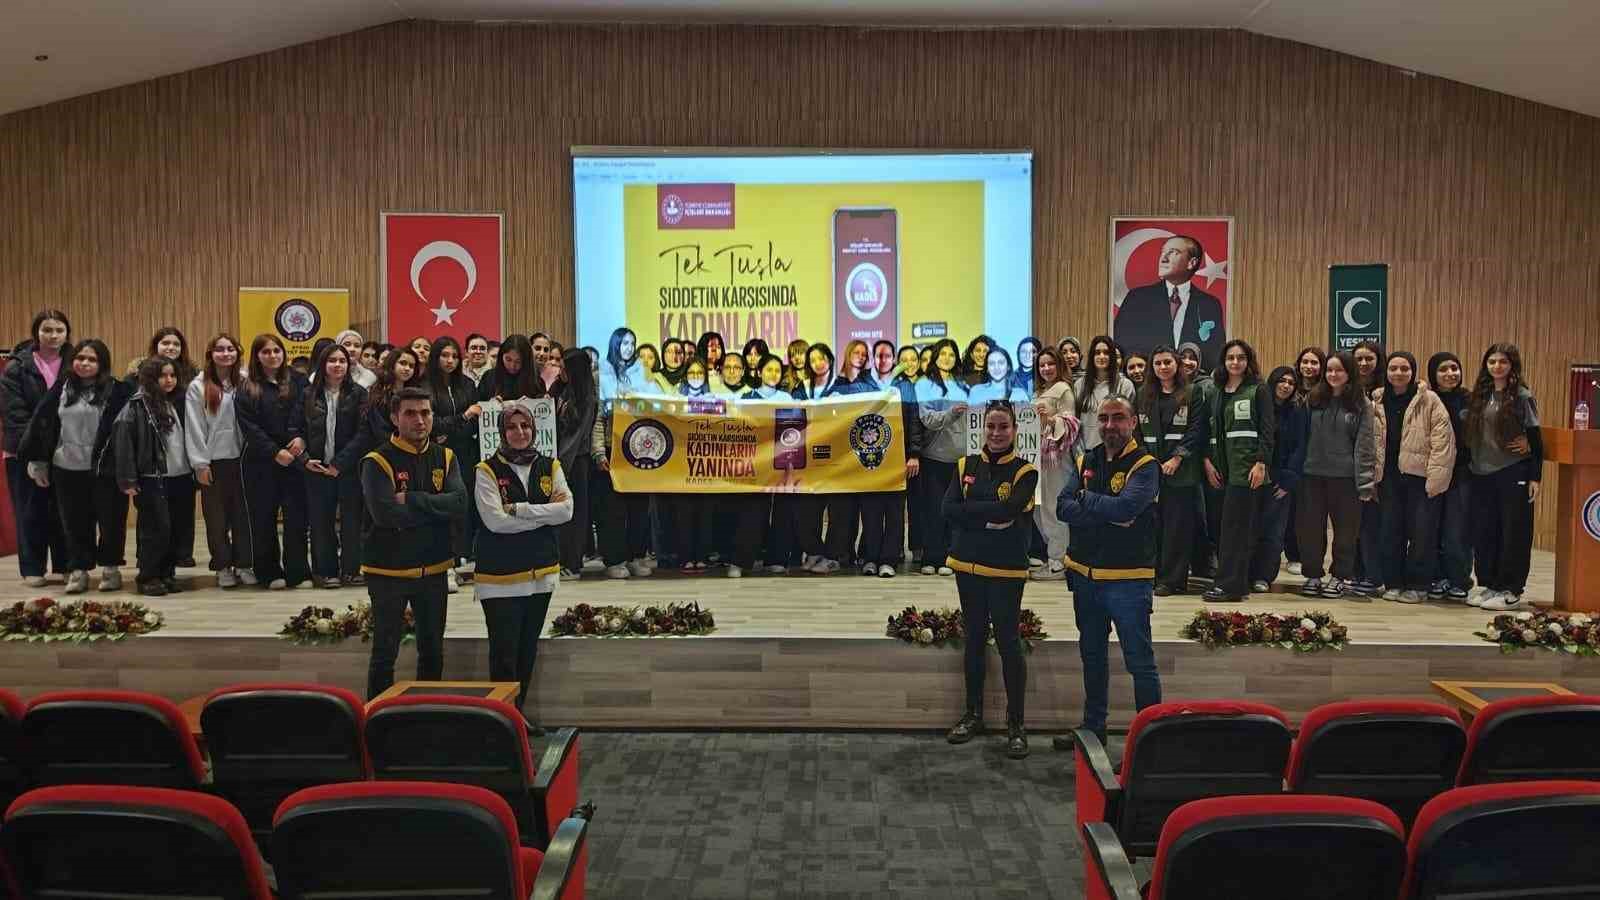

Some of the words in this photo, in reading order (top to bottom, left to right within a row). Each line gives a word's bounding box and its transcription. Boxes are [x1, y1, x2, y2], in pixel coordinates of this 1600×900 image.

[659, 244, 712, 287] Tek
[714, 240, 793, 286] Tuşla
[687, 441, 757, 457] KADINLARIN
[687, 457, 756, 477] YANINDA
